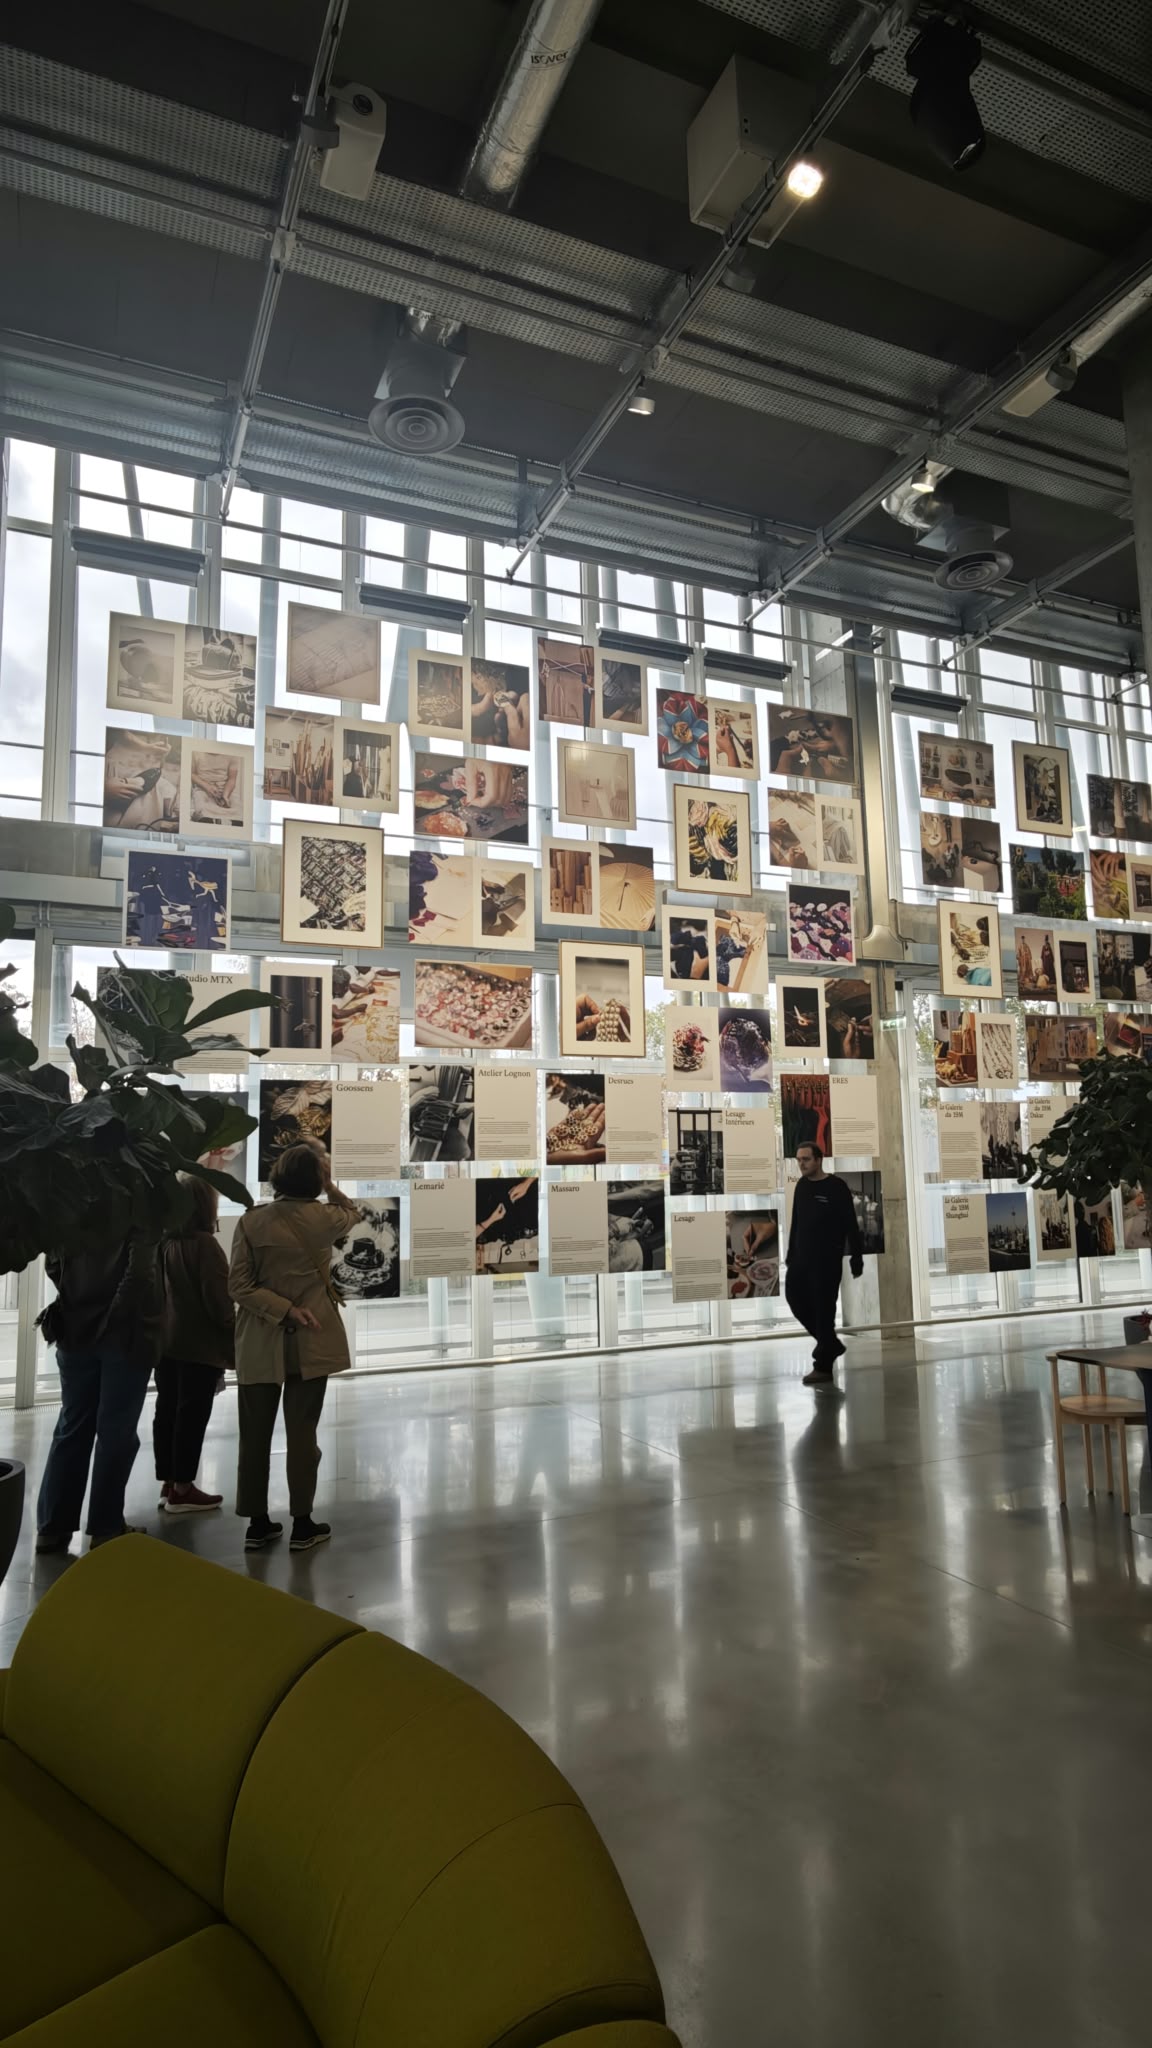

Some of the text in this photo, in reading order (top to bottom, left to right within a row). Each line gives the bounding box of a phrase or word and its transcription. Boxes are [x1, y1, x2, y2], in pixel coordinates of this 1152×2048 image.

[210, 974, 233, 985] MTX
[478, 1069, 531, 1079] Atelier Lognon
[832, 1077, 849, 1085] ERES
[336, 1083, 374, 1092] Goossens
[725, 1110, 746, 1119] Lesage
[551, 1184, 580, 1193] Massaro
[674, 1215, 696, 1224] Lesage
